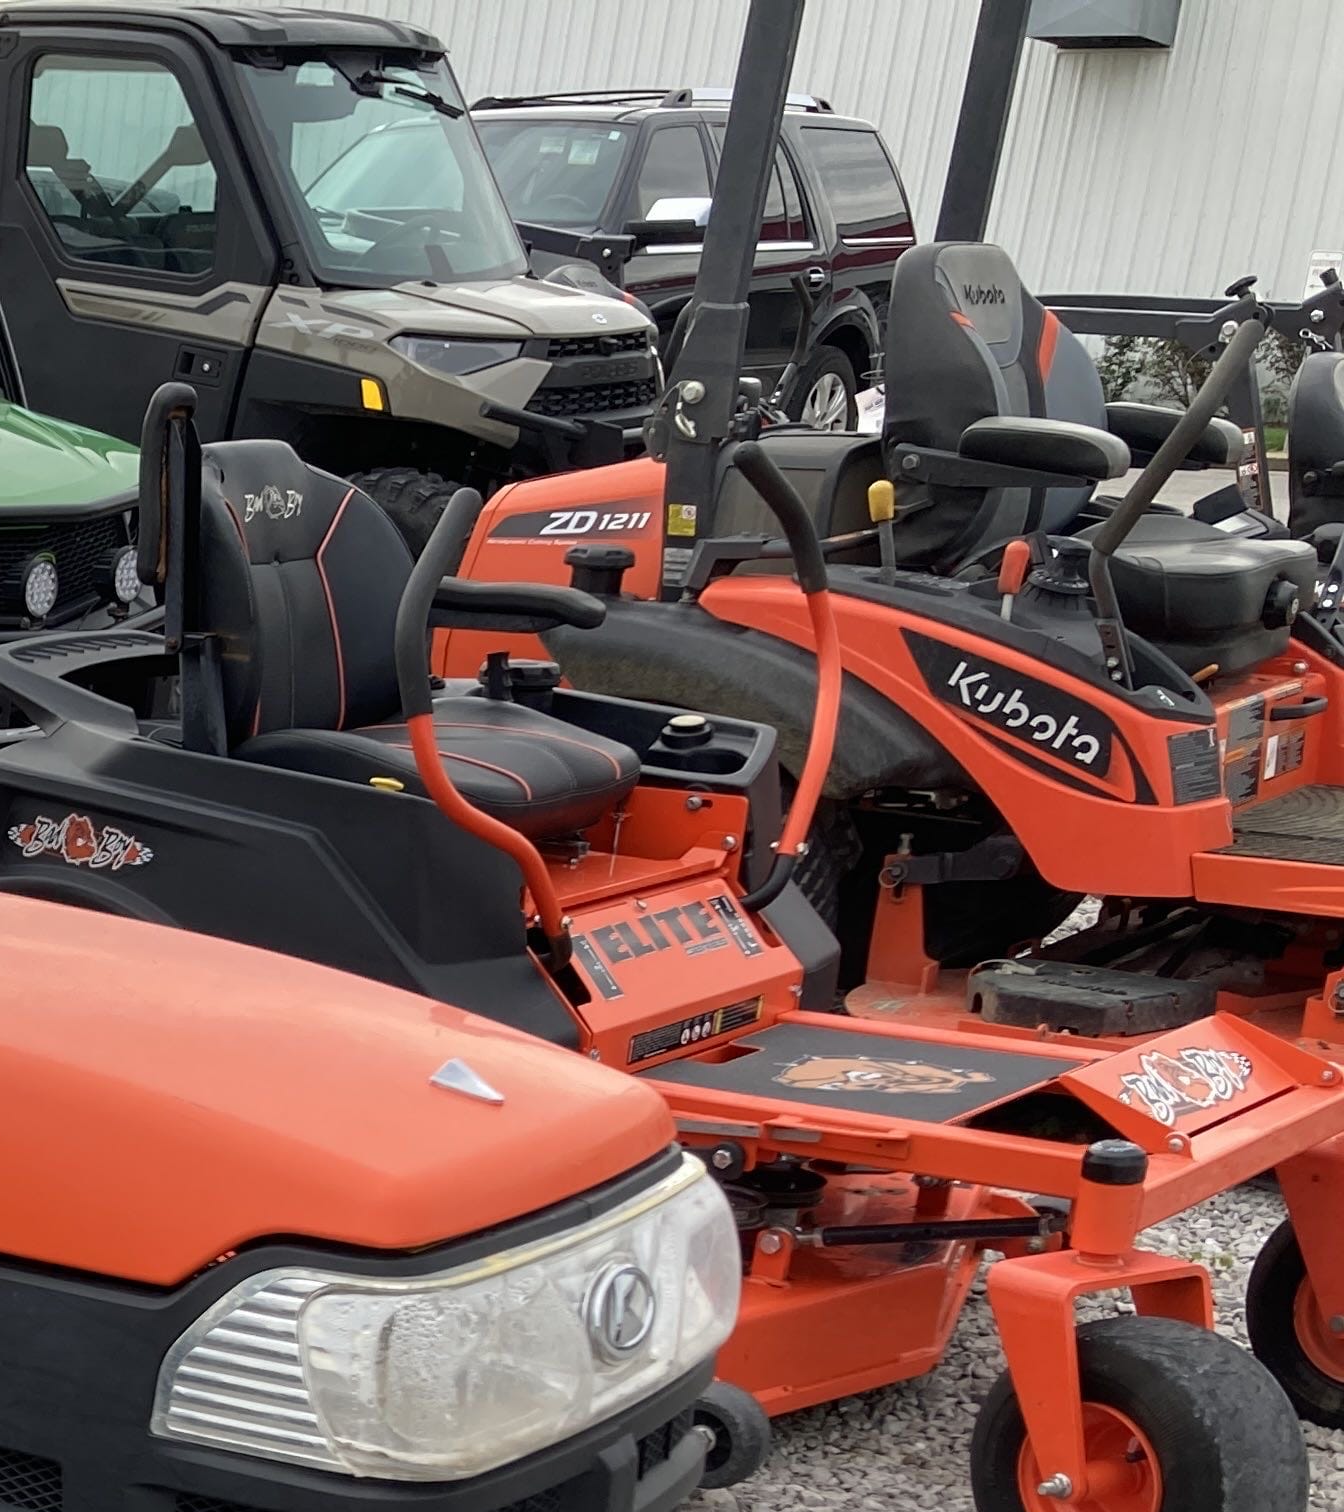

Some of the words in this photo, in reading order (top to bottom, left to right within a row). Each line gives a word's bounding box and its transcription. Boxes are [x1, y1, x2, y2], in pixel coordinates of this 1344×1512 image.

[963, 283, 1005, 305] Kubota
[266, 311, 374, 339] XP
[539, 511, 599, 535] ZD
[598, 512, 651, 532] 1211
[947, 661, 1100, 765] Kubota
[590, 900, 721, 964] ELITE
